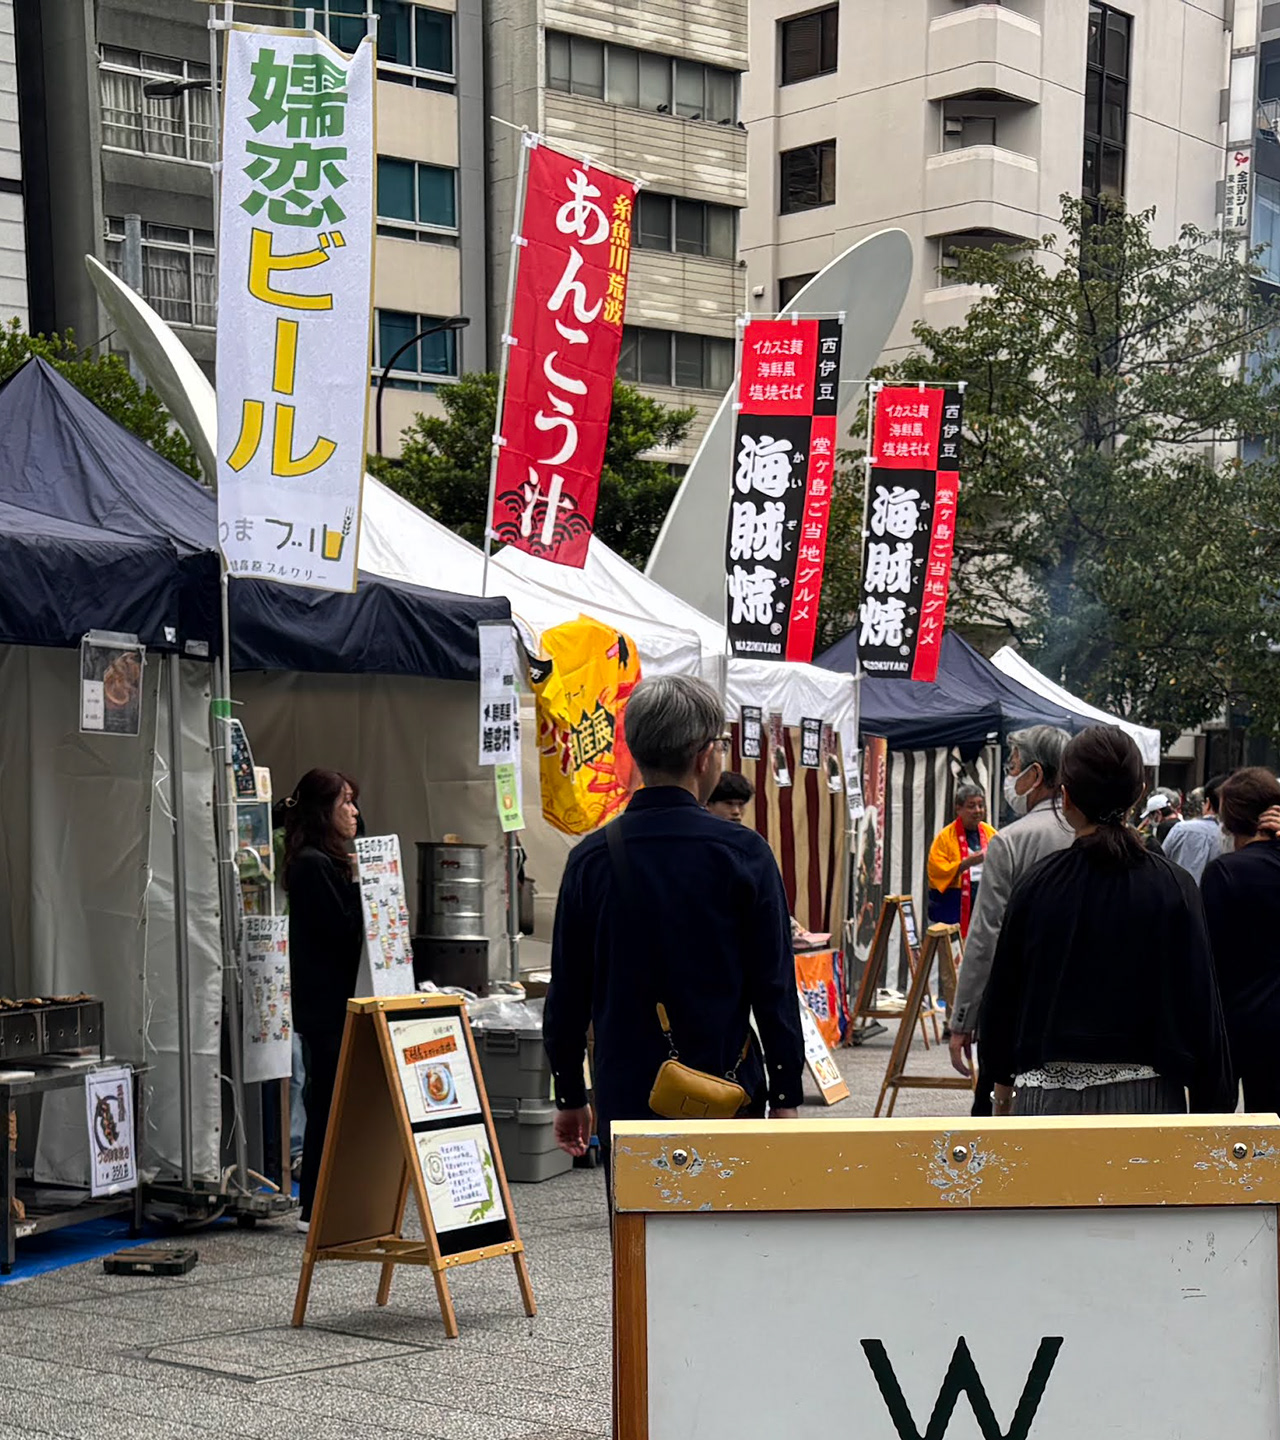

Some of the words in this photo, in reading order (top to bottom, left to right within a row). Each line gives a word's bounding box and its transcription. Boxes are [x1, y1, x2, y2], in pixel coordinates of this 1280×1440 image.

[226, 47, 347, 478] 嬬恋ビール
[521, 168, 610, 547] あんこう汁
[757, 361, 796, 378] 海鮮風
[817, 337, 838, 401] 西伊豆
[749, 384, 803, 401] 塩焼そば
[882, 442, 930, 457] 塩焼そば
[940, 405, 960, 458] 西伊豆
[727, 435, 794, 626] 海賊焼
[859, 485, 920, 648] 海賊焼
